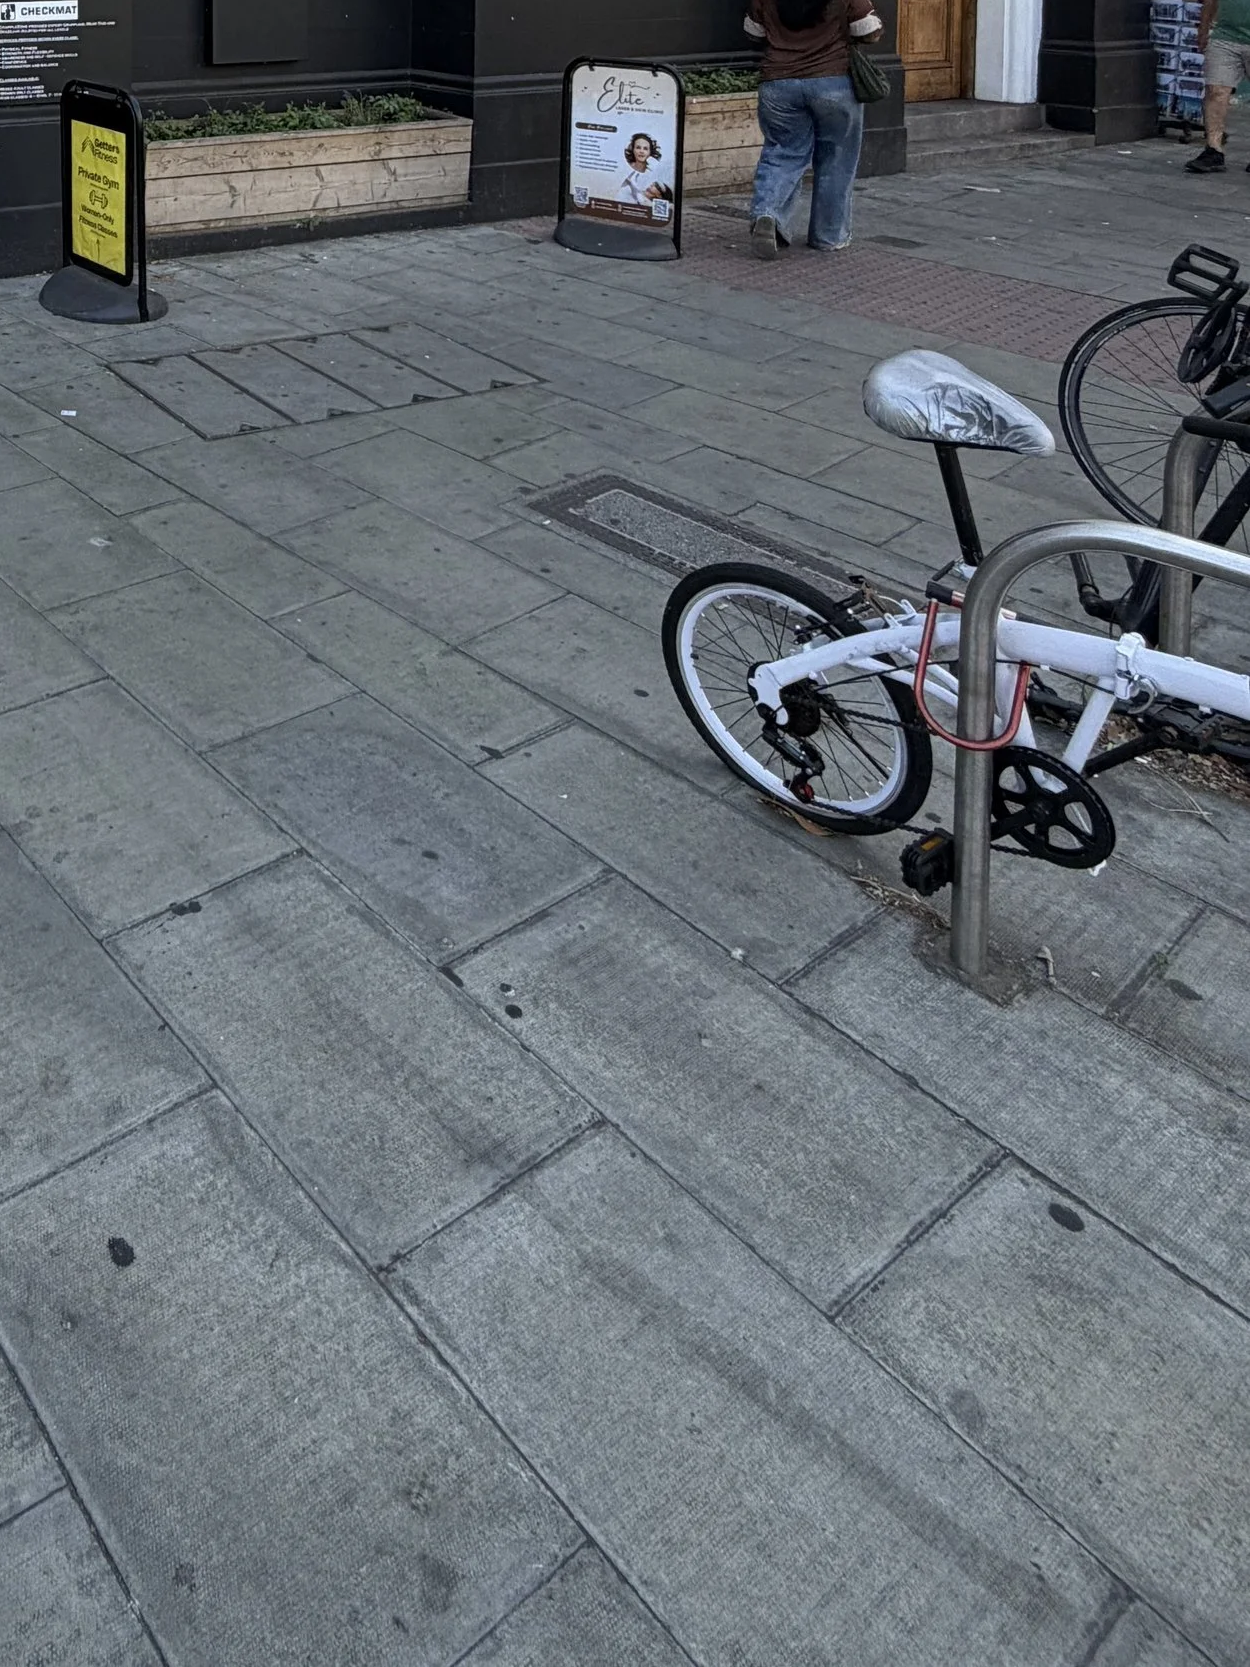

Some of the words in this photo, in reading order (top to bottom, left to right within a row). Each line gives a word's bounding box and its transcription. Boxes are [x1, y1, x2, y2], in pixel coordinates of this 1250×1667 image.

[21, 5, 77, 16] CHECKMAT
[597, 76, 644, 112] Elite
[94, 138, 120, 154] Getters
[94, 150, 118, 164] Fitness
[78, 166, 101, 183] Private
[102, 175, 120, 190] Gym
[81, 204, 114, 225] Women-Only
[79, 215, 96, 232] Fitness
[98, 223, 118, 239] Classes
